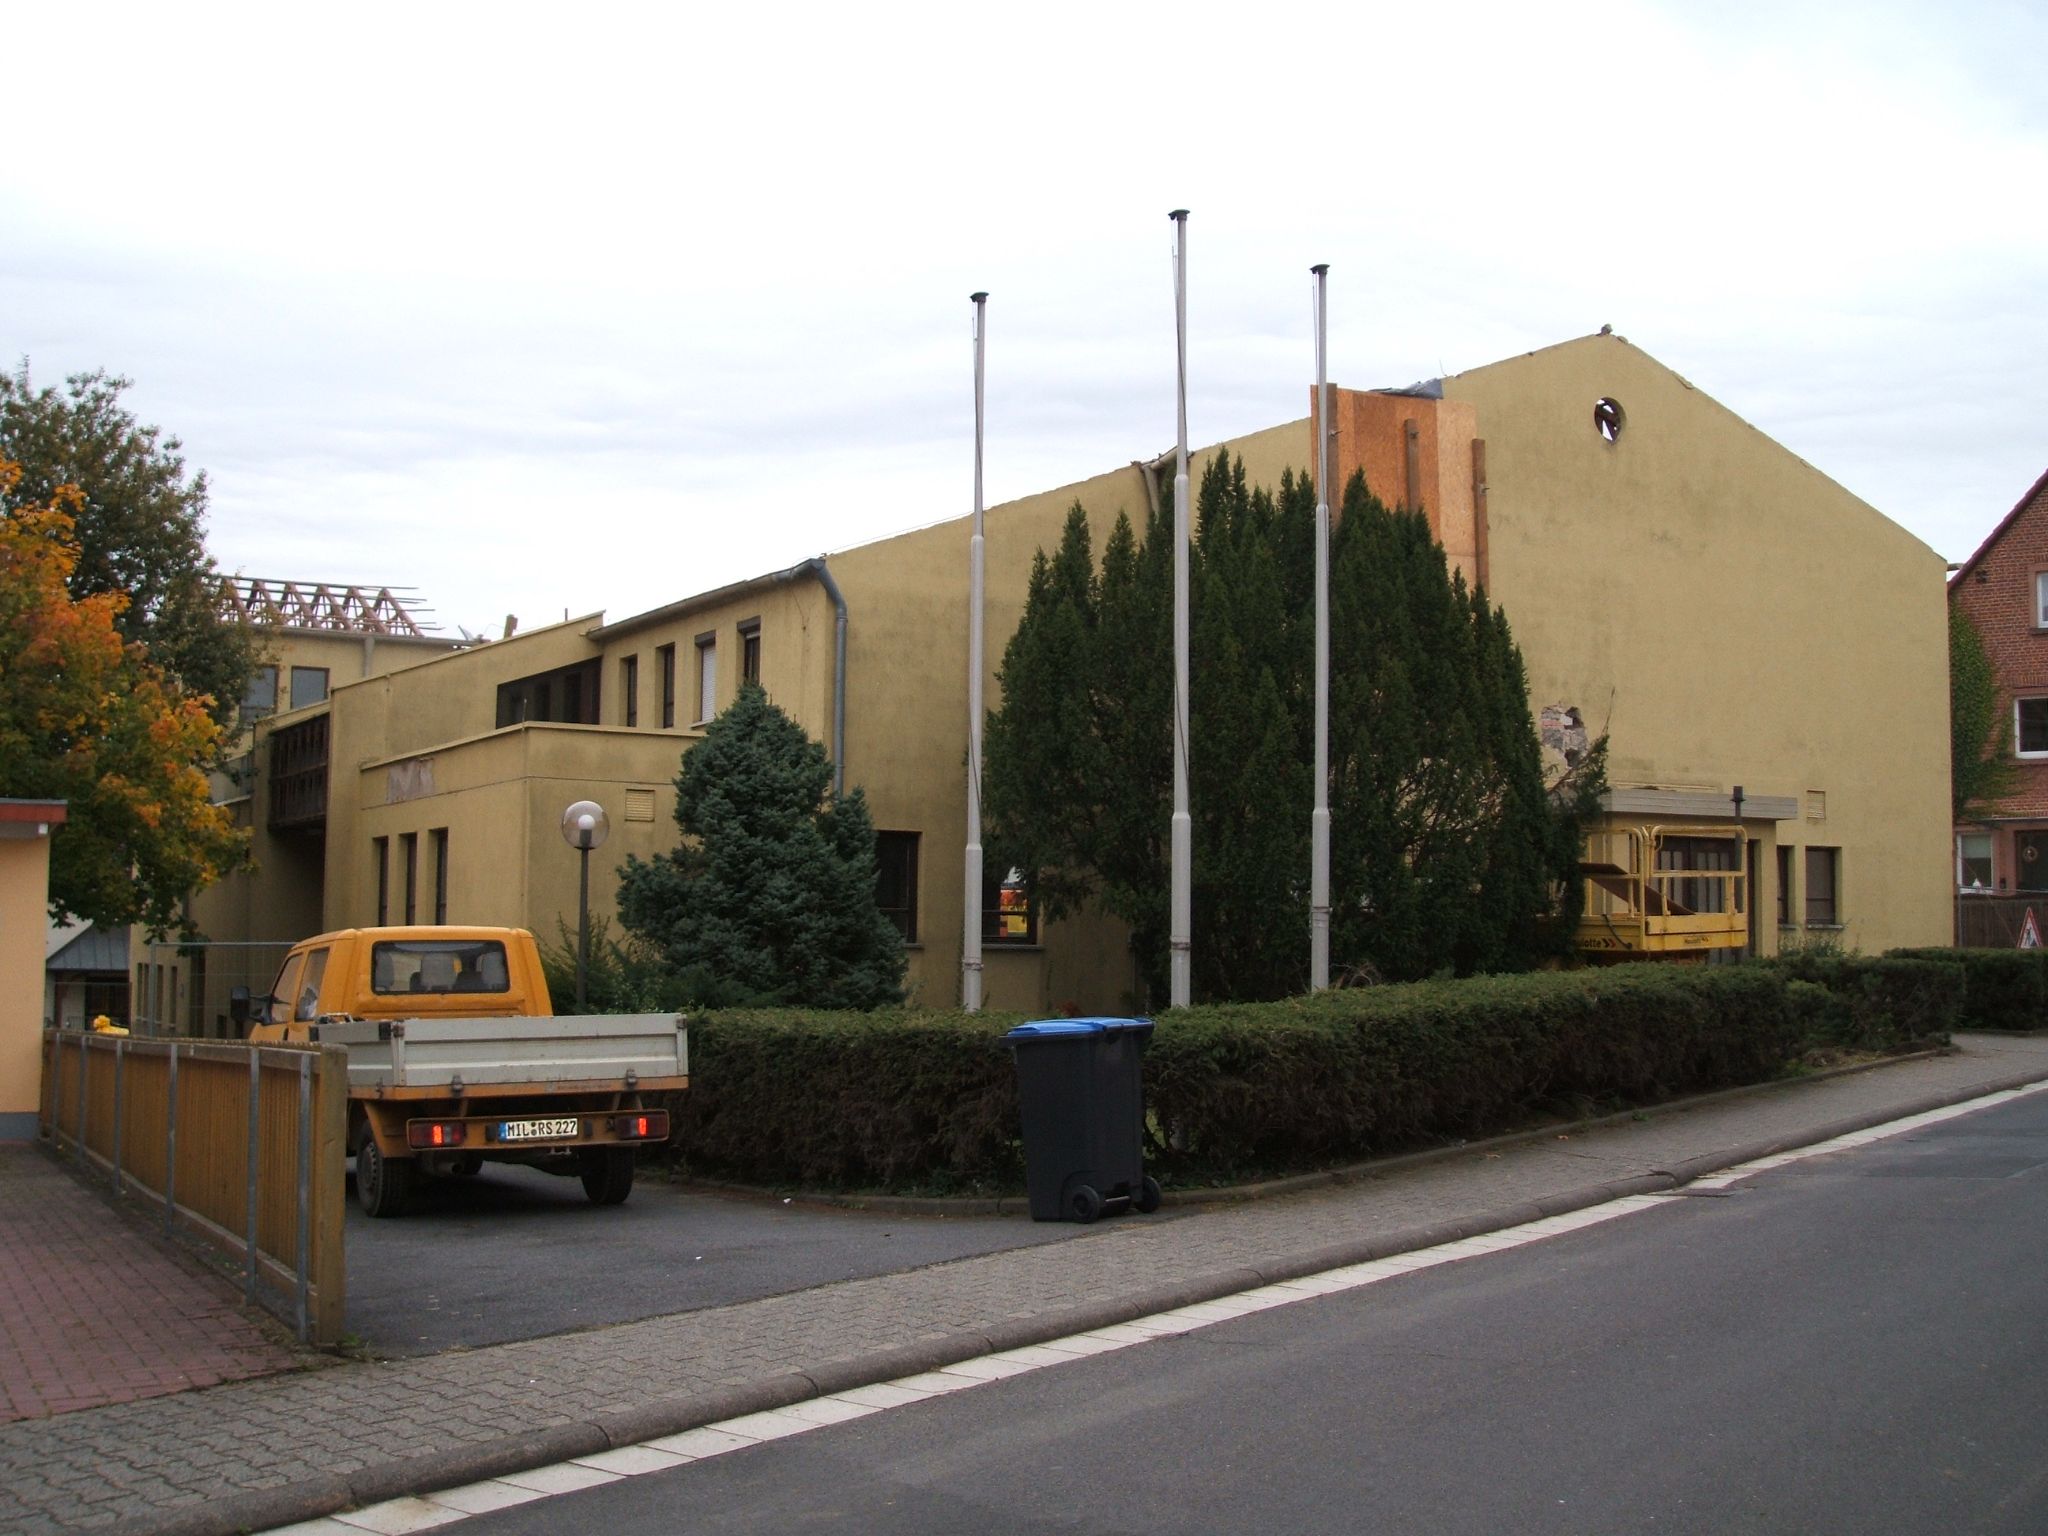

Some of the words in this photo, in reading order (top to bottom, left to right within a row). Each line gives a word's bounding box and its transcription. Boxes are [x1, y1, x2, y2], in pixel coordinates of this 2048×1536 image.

[507, 1123, 529, 1137] MIL
[538, 1121, 553, 1136] RS
[555, 1120, 577, 1135] 227
